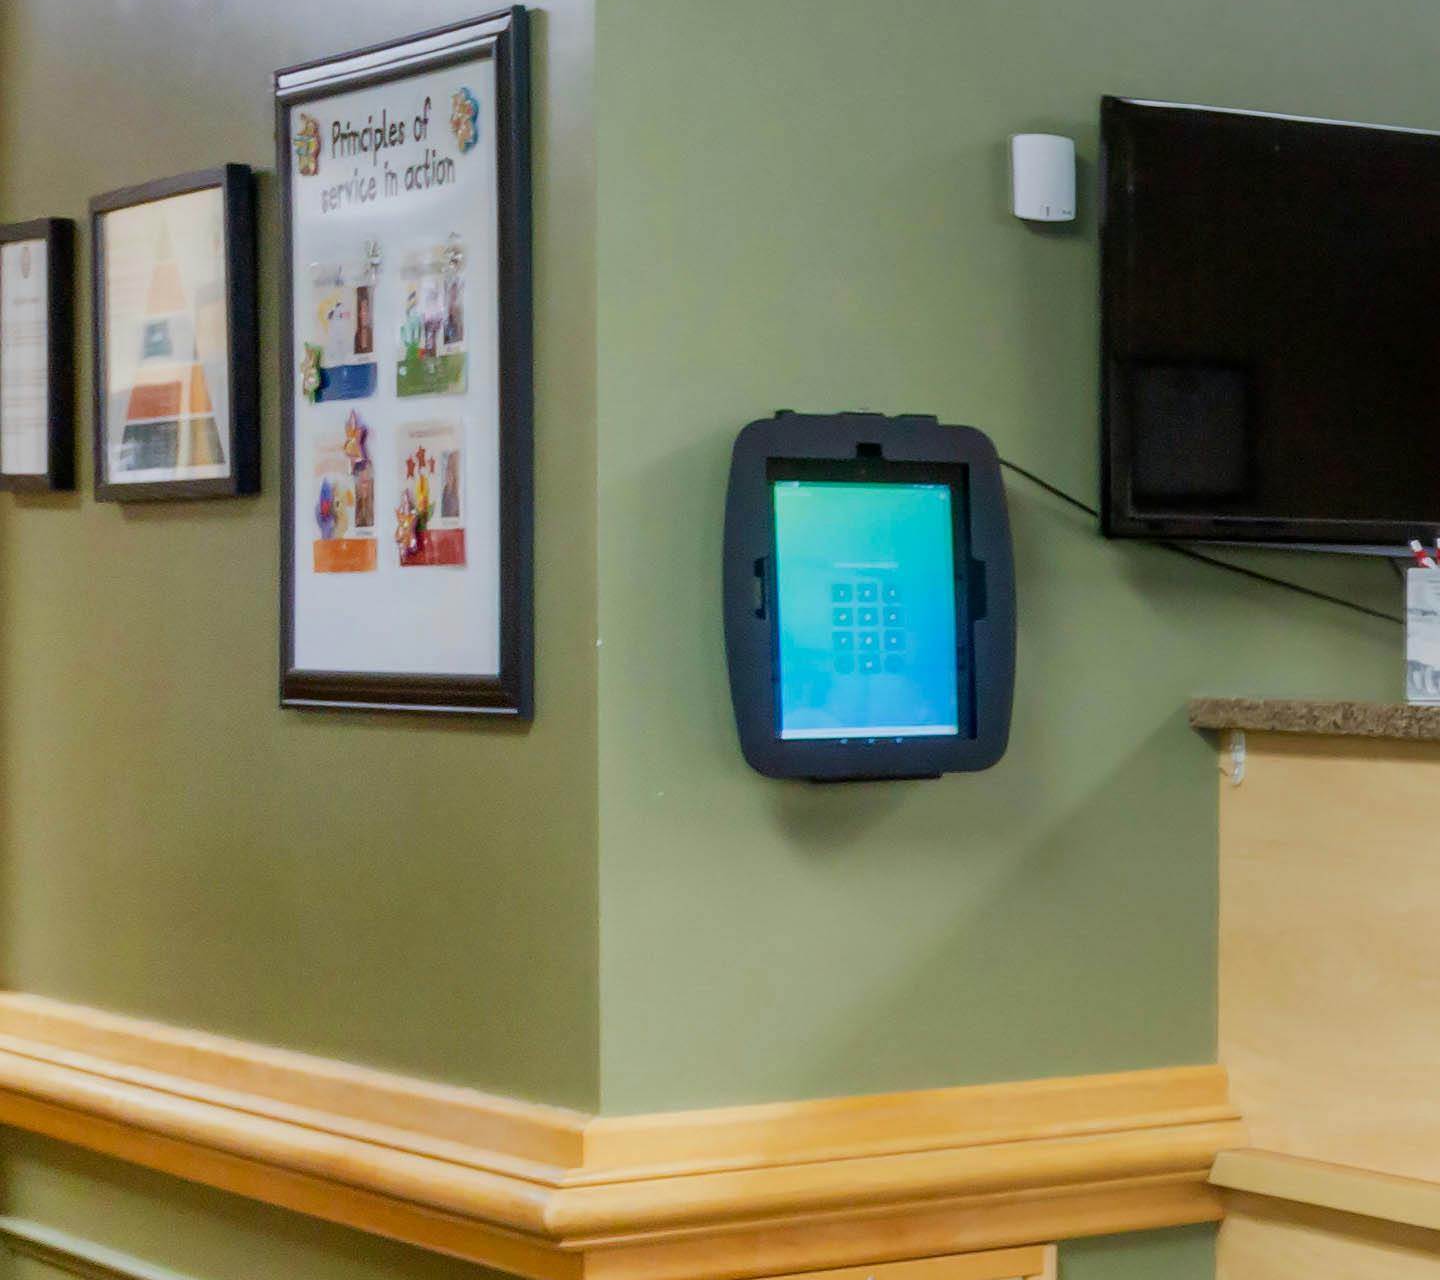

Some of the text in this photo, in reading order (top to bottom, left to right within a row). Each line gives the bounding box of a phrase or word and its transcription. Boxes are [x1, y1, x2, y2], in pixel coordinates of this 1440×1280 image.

[331, 96, 432, 166] Principles of
[321, 149, 456, 214] service in action
